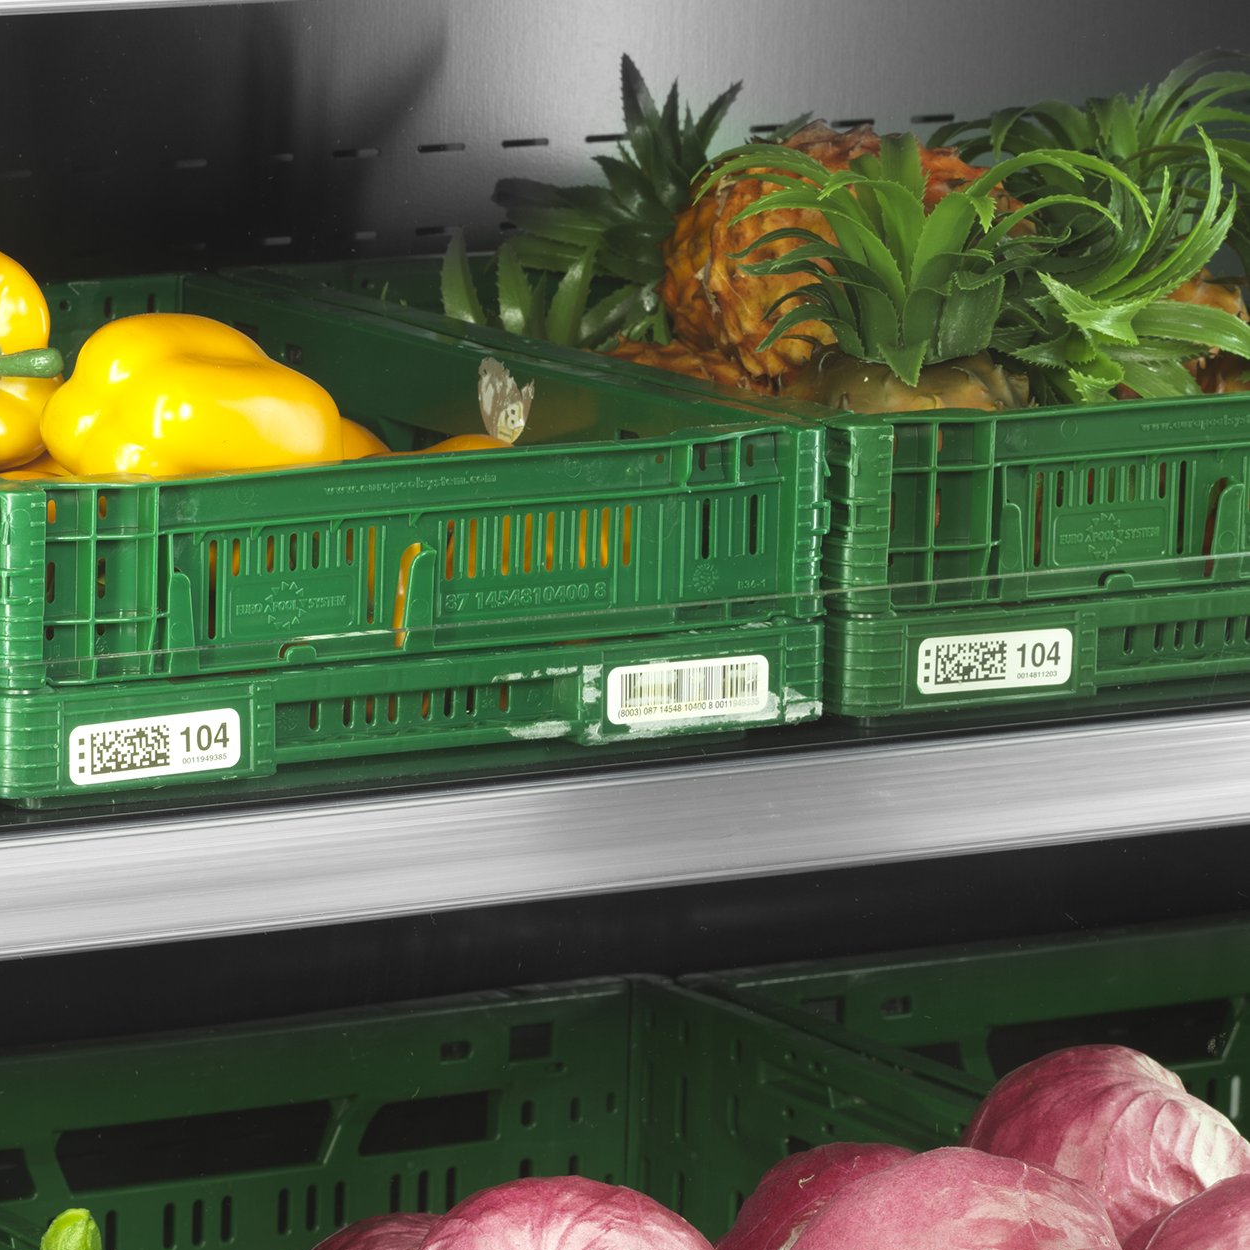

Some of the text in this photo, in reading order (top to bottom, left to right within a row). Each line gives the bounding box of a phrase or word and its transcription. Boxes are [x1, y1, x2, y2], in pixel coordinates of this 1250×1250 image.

[324, 472, 497, 496] www.europoolsystem.com
[1059, 525, 1160, 546] EURO POOL SYSTEM
[307, 594, 347, 609] SYSTEM
[443, 580, 608, 613] 87 1454810400 8
[1015, 640, 1062, 669] 104
[1016, 669, 1058, 680] 0014811203
[617, 707, 642, 720] (8003)
[643, 706, 657, 716] 087
[659, 703, 682, 714] 14548
[684, 701, 707, 712] 10400
[708, 700, 714, 711] 8
[179, 721, 230, 753] 104
[181, 752, 228, 765] 0011949385
